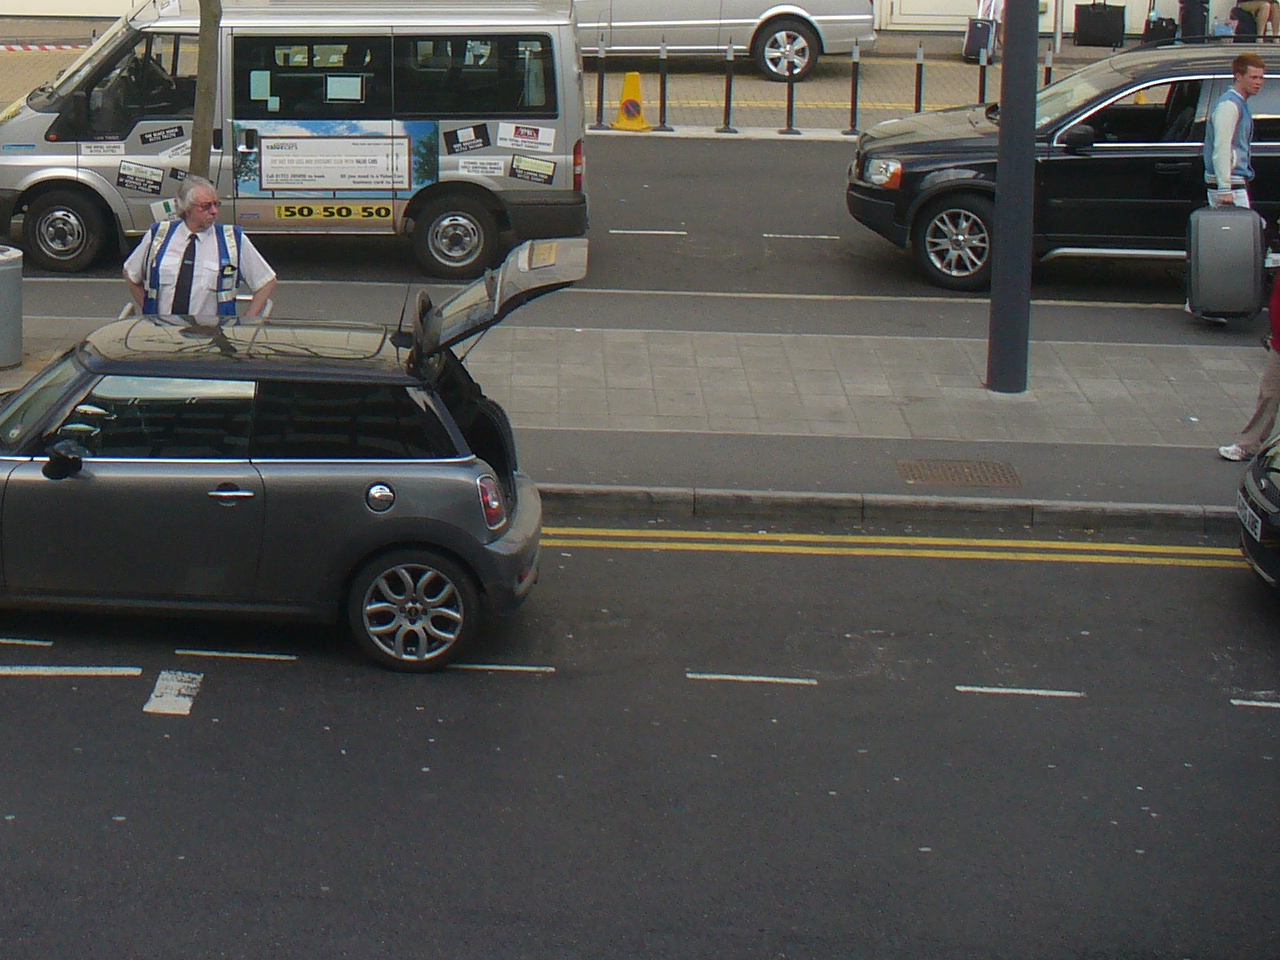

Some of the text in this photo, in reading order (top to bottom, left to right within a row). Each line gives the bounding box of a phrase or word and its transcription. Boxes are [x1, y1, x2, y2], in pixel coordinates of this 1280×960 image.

[284, 206, 313, 218] 50
[322, 206, 352, 218] 50
[361, 206, 391, 218] 50
